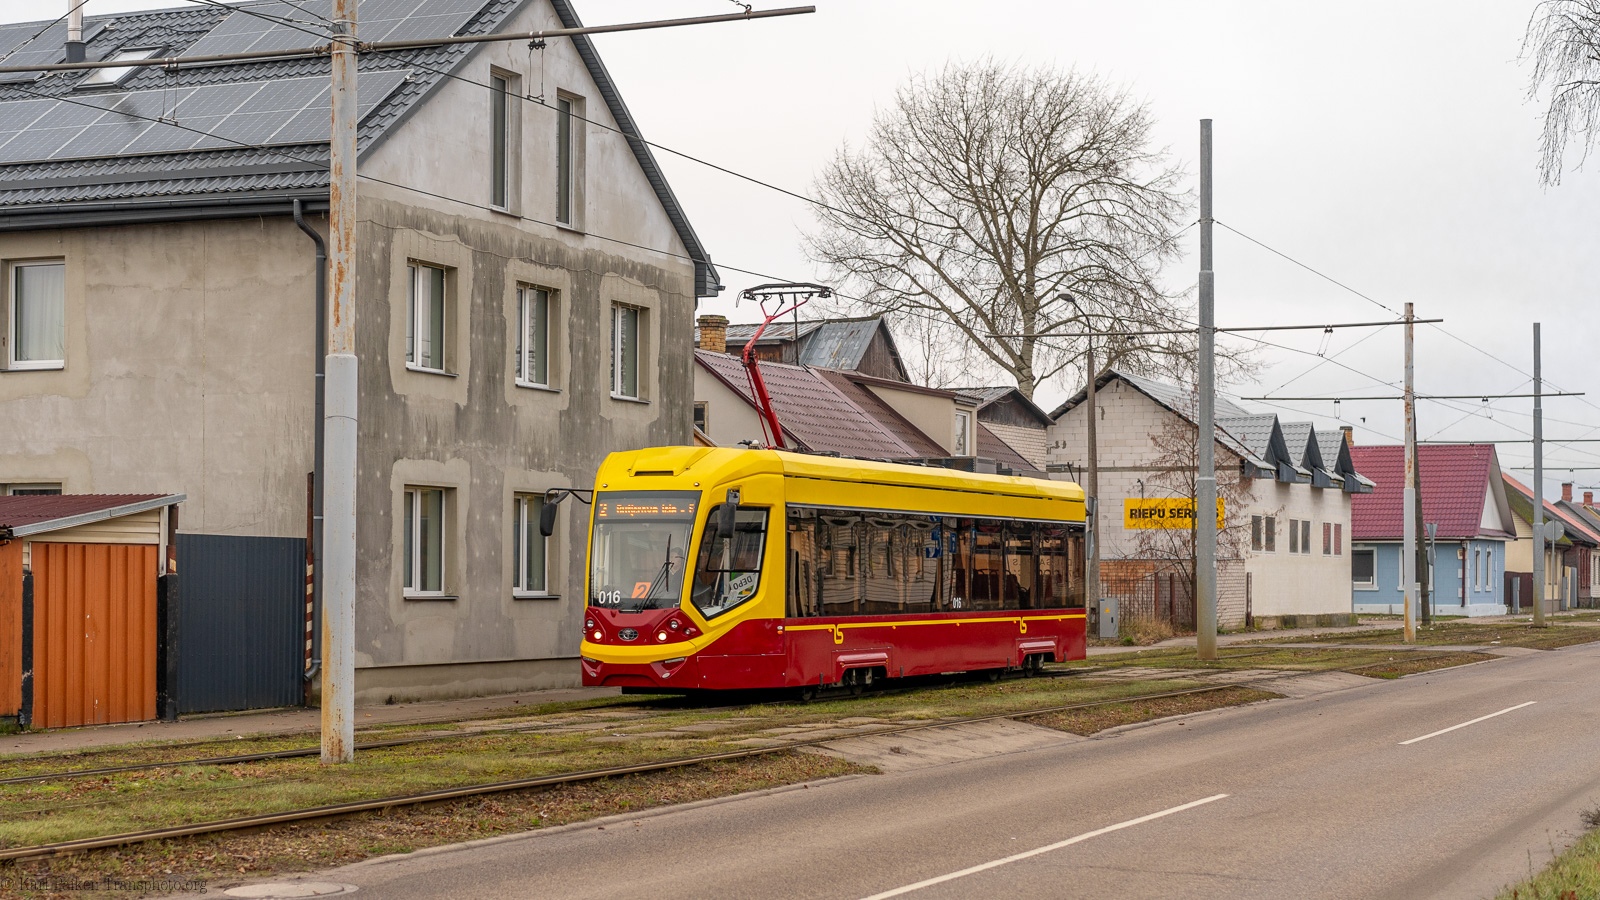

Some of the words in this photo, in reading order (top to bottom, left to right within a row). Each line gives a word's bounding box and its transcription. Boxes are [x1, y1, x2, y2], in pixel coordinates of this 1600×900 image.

[599, 503, 608, 517] 2
[1129, 508, 1166, 519] RIEPU
[732, 575, 753, 590] DEPO
[598, 590, 621, 604] 016
[637, 584, 648, 599] 2
[952, 597, 962, 609] 016
